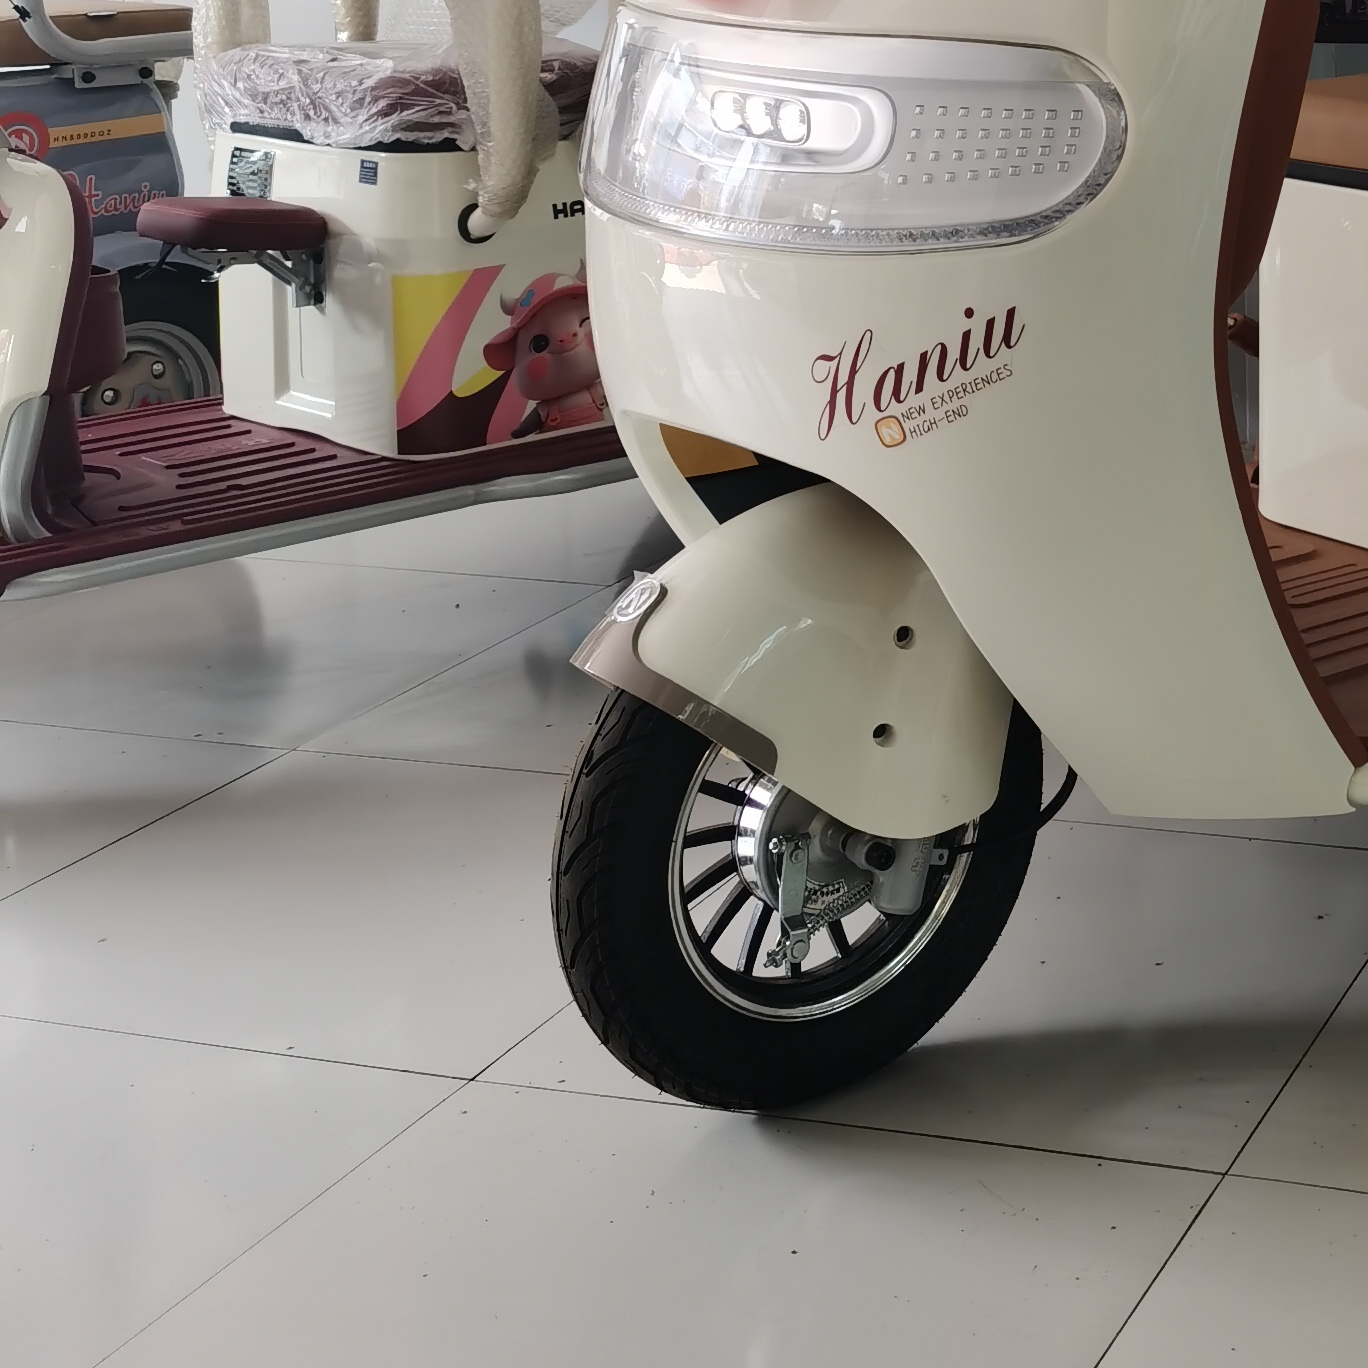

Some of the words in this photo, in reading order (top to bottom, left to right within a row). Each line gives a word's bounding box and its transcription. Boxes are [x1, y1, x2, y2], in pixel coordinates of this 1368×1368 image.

[811, 305, 1026, 442] Haniu
[900, 402, 926, 424] NEW
[930, 363, 1013, 411] EXPERIENCES
[908, 404, 969, 440] HIGH-END
